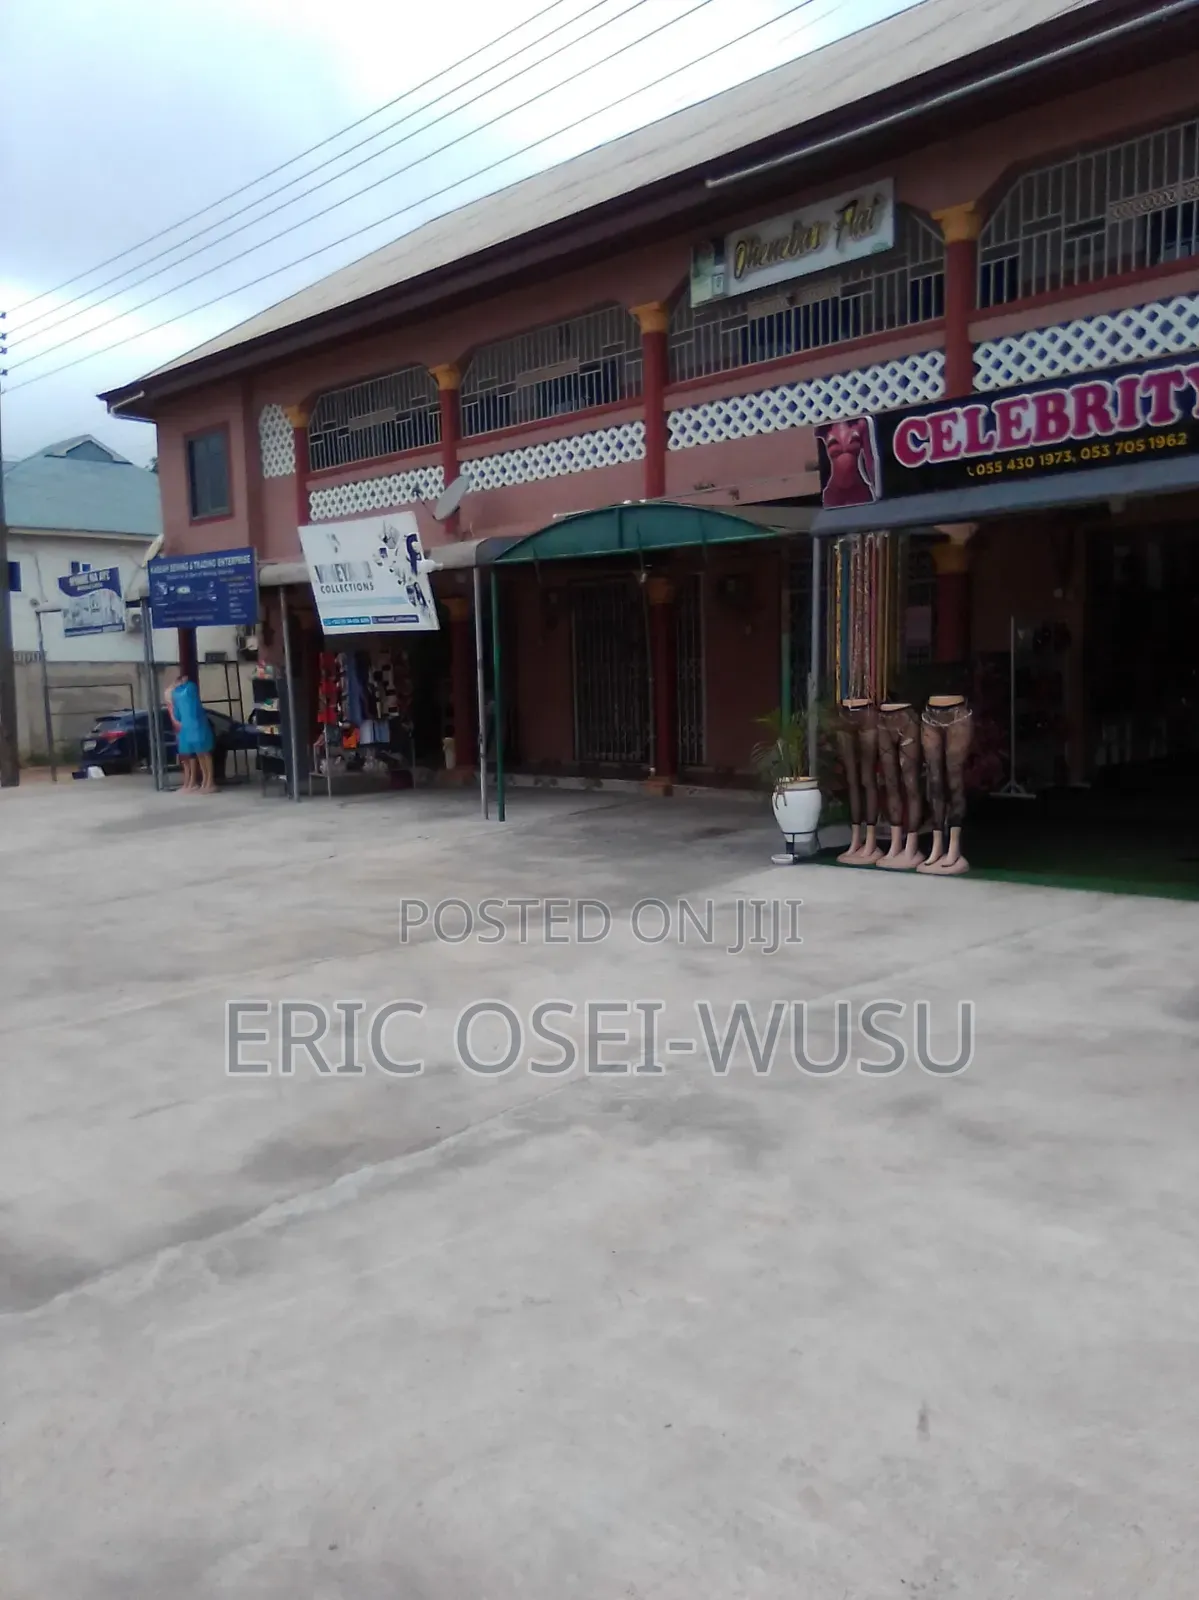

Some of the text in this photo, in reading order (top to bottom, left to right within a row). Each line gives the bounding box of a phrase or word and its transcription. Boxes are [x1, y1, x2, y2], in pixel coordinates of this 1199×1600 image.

[976, 461, 1002, 476] 055
[1006, 457, 1035, 471] 430
[1080, 444, 1111, 460] 053
[1115, 438, 1146, 455] 705
[1148, 432, 1188, 449] 1962
[217, 554, 251, 568] ENTERPRISE
[320, 581, 376, 594] COLLECTIONS
